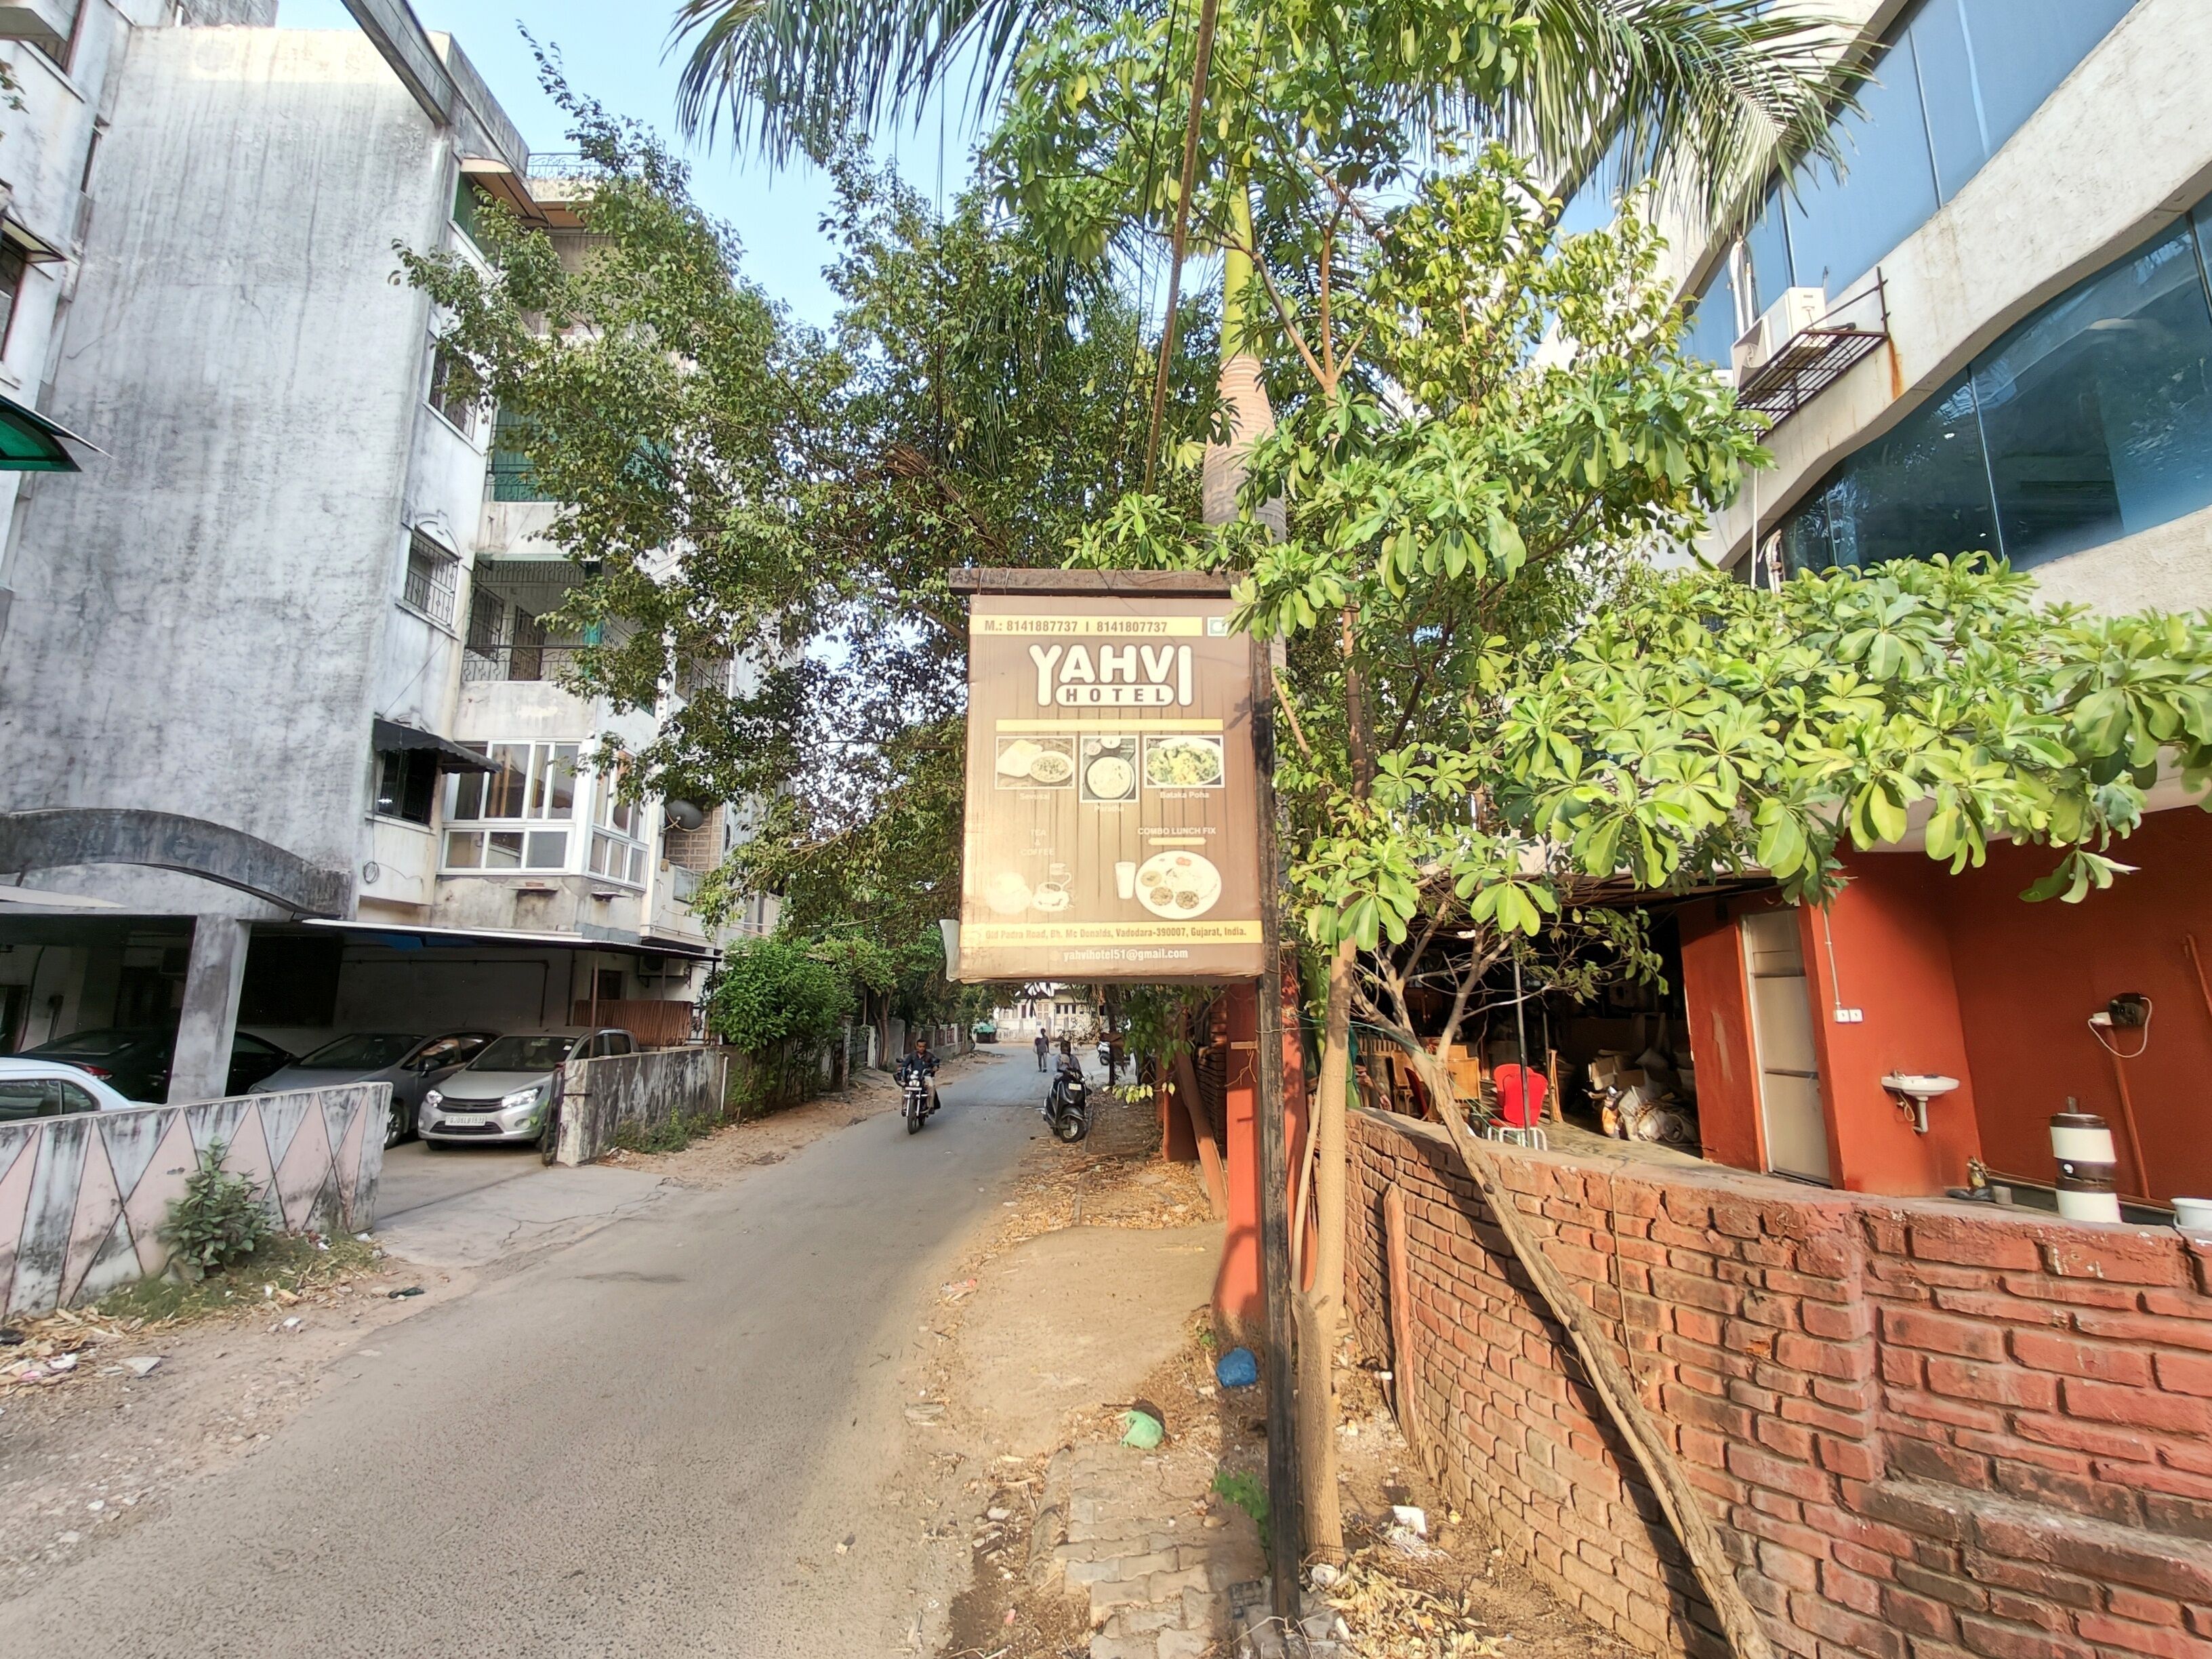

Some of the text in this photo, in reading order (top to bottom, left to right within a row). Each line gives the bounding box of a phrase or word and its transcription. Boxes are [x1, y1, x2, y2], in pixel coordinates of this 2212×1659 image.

[985, 620, 1002, 631] M.:
[1006, 620, 1078, 632] 8141887737
[1097, 621, 1168, 632] 8141807737
[1028, 644, 1193, 707] YAHVI
[1065, 688, 1165, 702] HOTEL
[1160, 791, 1187, 799] Bataka
[1030, 829, 1047, 837] TEA
[1137, 827, 1170, 835] COMBO
[1171, 827, 1201, 835] LUNCH
[1019, 848, 1055, 856] COFFEE
[986, 930, 998, 939] Old
[1001, 930, 1023, 939] Padra
[1026, 929, 1048, 939] Road,
[1066, 929, 1078, 939] Mc
[1080, 928, 1113, 939] Donalds,
[1115, 927, 1189, 938] Vadodara-390007,
[1191, 926, 1222, 938] Gujarat,
[1225, 926, 1246, 936] India.
[1063, 947, 1188, 962] yahvihotel51@gmail.com
